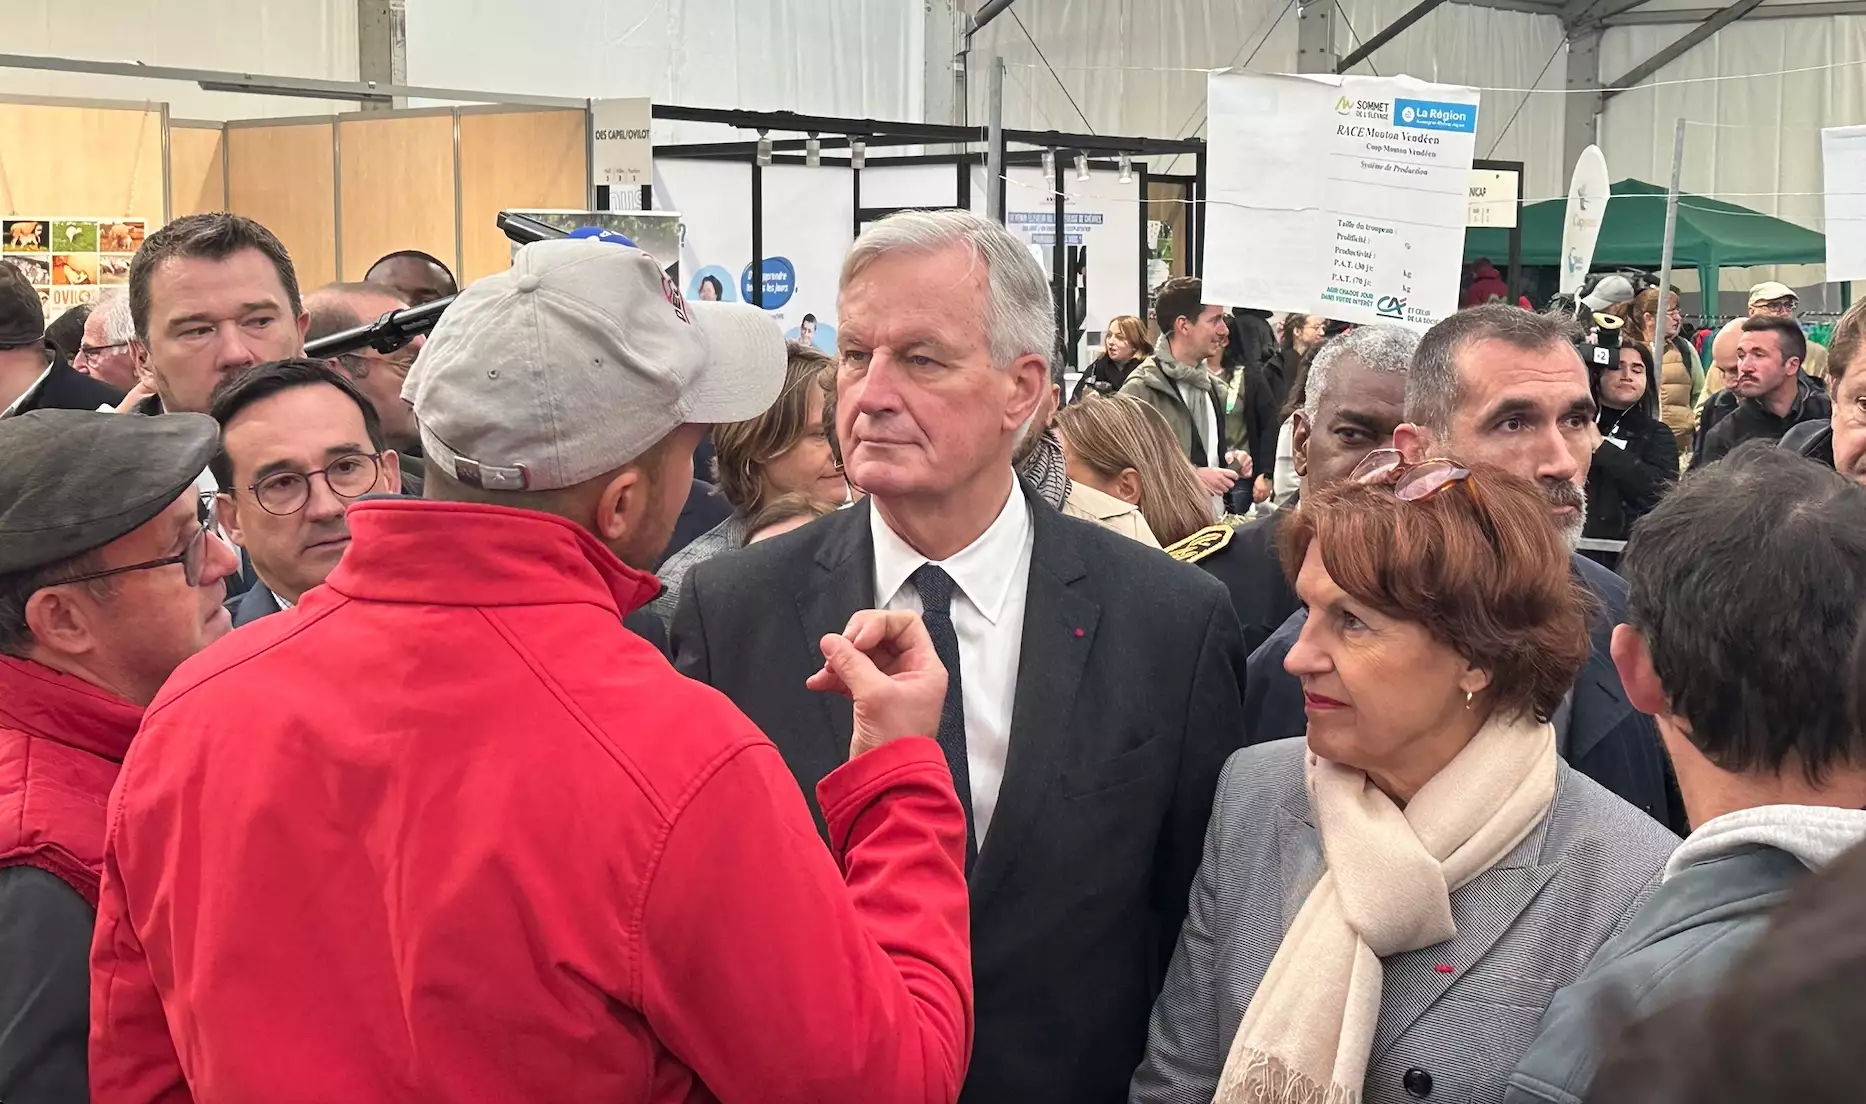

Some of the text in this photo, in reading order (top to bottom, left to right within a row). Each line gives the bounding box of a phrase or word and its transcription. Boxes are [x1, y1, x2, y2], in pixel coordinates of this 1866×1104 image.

[1357, 99, 1389, 113] SOMMET
[1416, 107, 1466, 122] La Région
[1336, 124, 1440, 145] RACE Mouton Vendéen
[1366, 142, 1437, 158] Coop Mouton Vendéen
[1360, 160, 1428, 176] Système de Production
[1407, 315, 1415, 323] DE
